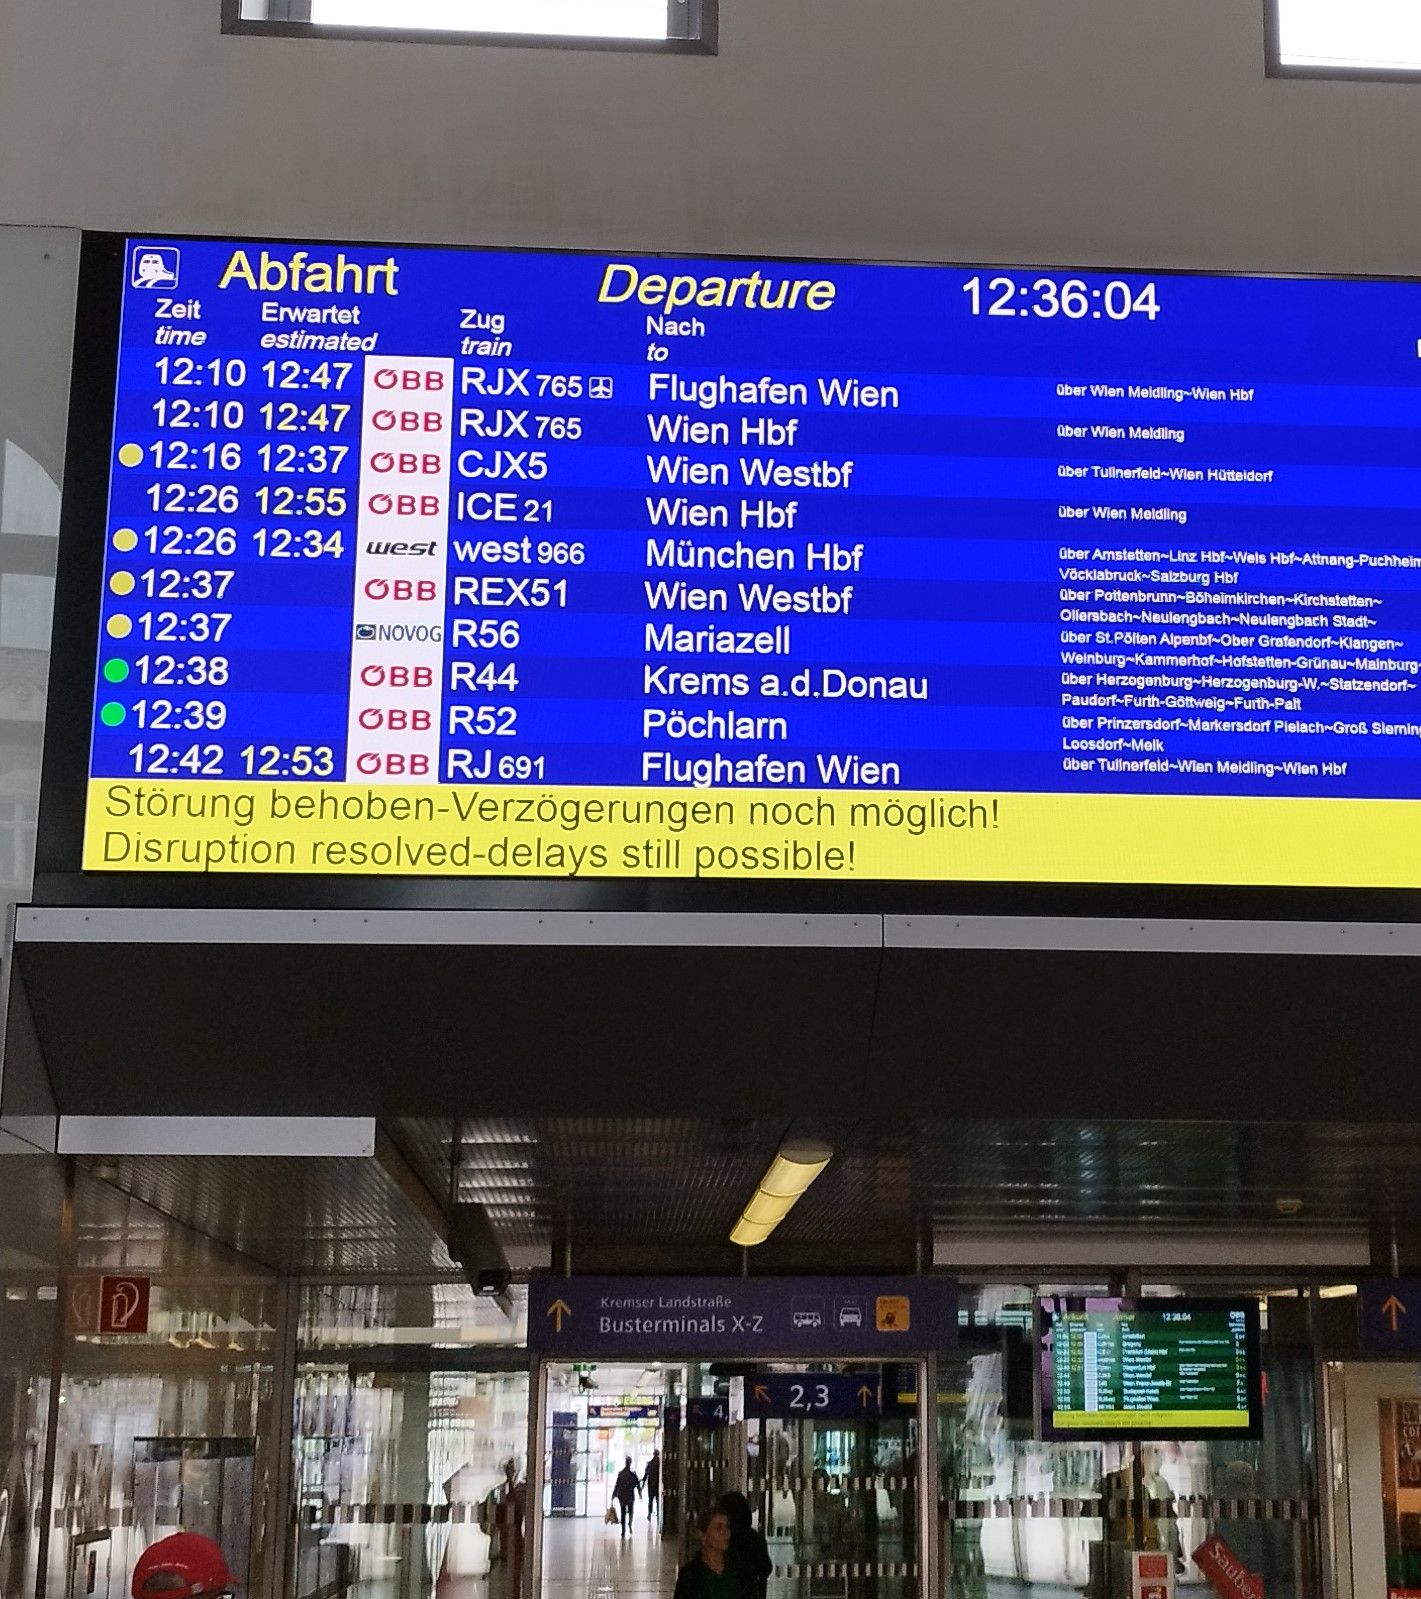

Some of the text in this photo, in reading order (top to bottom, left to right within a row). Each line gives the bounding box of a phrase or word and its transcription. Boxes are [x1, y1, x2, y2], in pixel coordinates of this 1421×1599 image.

[218, 251, 1160, 320] Abfahrt Departure 12:36:04
[155, 299, 201, 320] Zeit
[262, 302, 360, 324] Erwartet
[460, 309, 504, 334] Zug
[647, 315, 705, 336] Nach
[155, 326, 206, 345] time
[261, 330, 378, 351] estimated
[461, 337, 512, 356] train
[647, 343, 668, 361] to
[156, 357, 246, 386] 12:10
[262, 361, 352, 390] 12:47
[462, 367, 530, 396] RJX
[536, 375, 582, 397] 765
[650, 373, 807, 409] Flughafen
[818, 378, 898, 407] Wien
[1057, 384, 1086, 396] über
[1090, 385, 1124, 397] Wien
[1230, 389, 1254, 400] Hbf
[150, 441, 241, 470] 12:16
[258, 443, 349, 473] 12:37
[458, 450, 547, 479] CJX5
[647, 455, 728, 485] Wien
[740, 458, 853, 487] Westbf
[1058, 466, 1088, 477] über
[1208, 469, 1273, 481] Hütteldorf
[145, 526, 236, 555] 12:26
[253, 528, 344, 558] 12:34
[367, 542, 436, 555] west
[453, 536, 531, 563] west
[538, 542, 584, 564] 966
[647, 539, 794, 570] München
[808, 543, 864, 571] Hbf
[141, 569, 234, 598] 12:37
[454, 577, 566, 607] REX51
[645, 581, 727, 610] Wien
[738, 584, 853, 614] Westbf
[139, 612, 232, 642] 12:37
[380, 626, 440, 641] NOVOG
[453, 619, 519, 648] R56
[646, 623, 789, 654] Mariazell
[1061, 631, 1092, 643] über
[136, 655, 228, 685] 12:38
[451, 662, 519, 691] R44
[645, 665, 749, 695] Krems
[761, 669, 927, 699] a.d.Donau
[132, 700, 226, 729] 12:39
[449, 706, 516, 735] R52
[644, 709, 786, 739] Pöchlarn
[129, 744, 223, 774] 12:42
[241, 745, 333, 776] 12:53
[448, 749, 491, 778] RJ
[499, 756, 544, 779] 691
[643, 752, 805, 788] Flughafen
[817, 755, 899, 784] Wien
[106, 786, 998, 835] Störung behoben-Verzögerungen noch möglich!
[104, 831, 854, 877] Disruption resolved-delays still possible!
[600, 1296, 732, 1309] Kremser Landstraße
[600, 1315, 763, 1334] Busterminals X-Z
